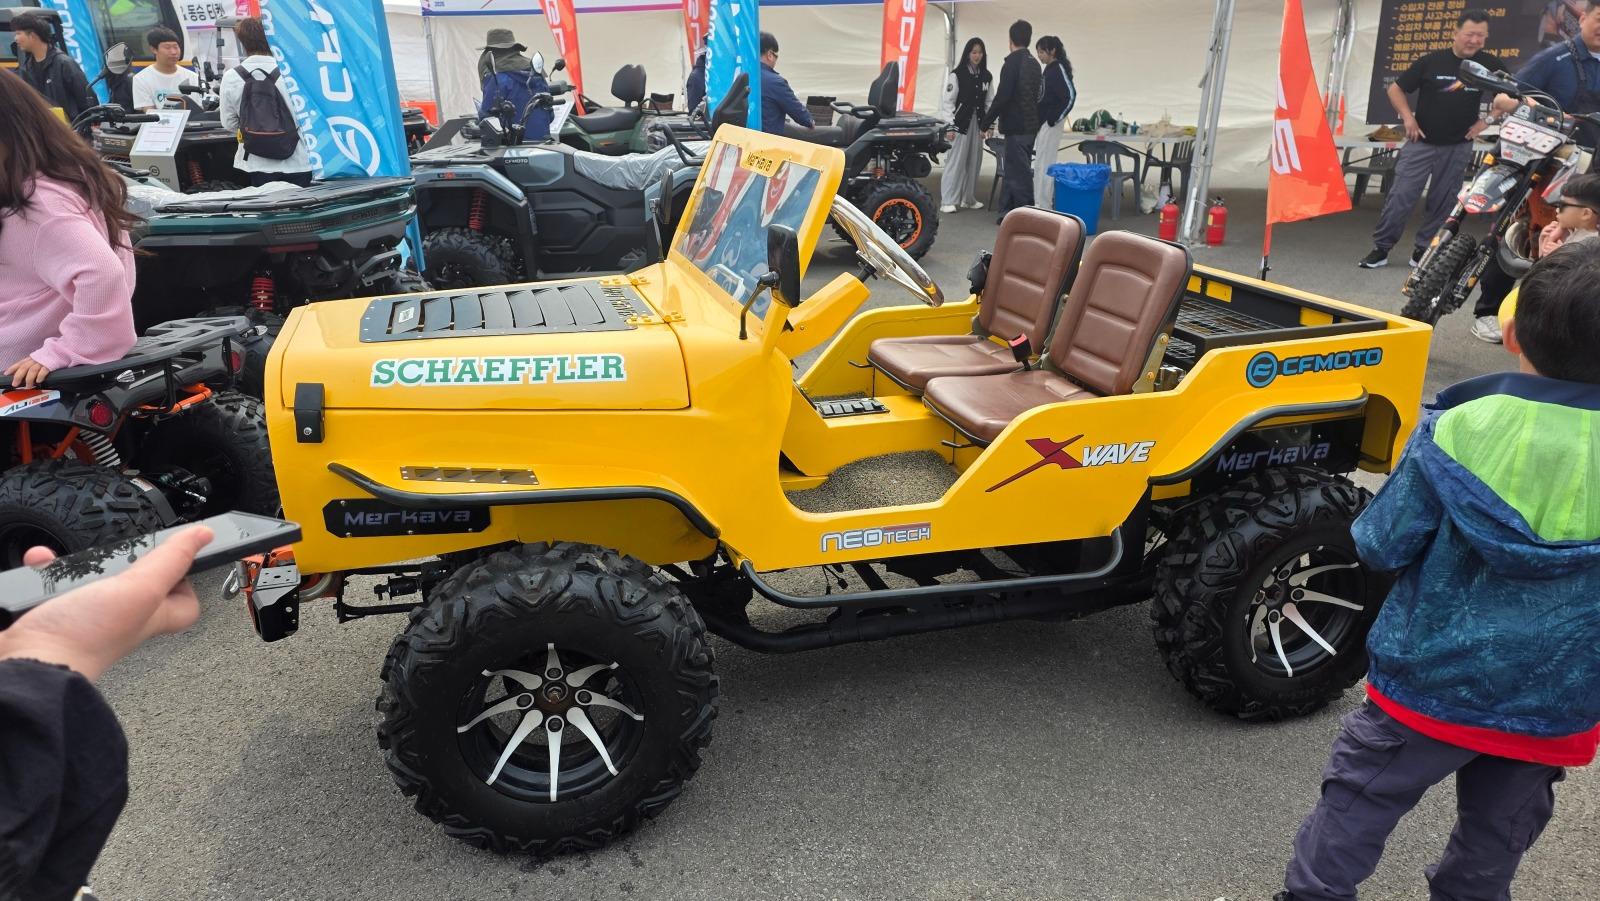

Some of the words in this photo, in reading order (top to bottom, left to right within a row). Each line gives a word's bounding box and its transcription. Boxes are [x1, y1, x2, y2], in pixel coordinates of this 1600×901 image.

[187, 5, 206, 21] 동승
[1400, 3, 1425, 11] 수입차
[1427, 2, 1445, 10] 전문
[1447, 0, 1465, 9] 정비
[1397, 23, 1421, 32] 수입차
[1395, 34, 1412, 42] 수입
[1414, 32, 1440, 41] 타이어
[982, 82, 989, 91] M
[1282, 347, 1382, 375] CFMOTO
[372, 354, 626, 386] SCHAEFFLER
[1216, 441, 1331, 473] Merkava
[344, 509, 471, 526] Merkava
